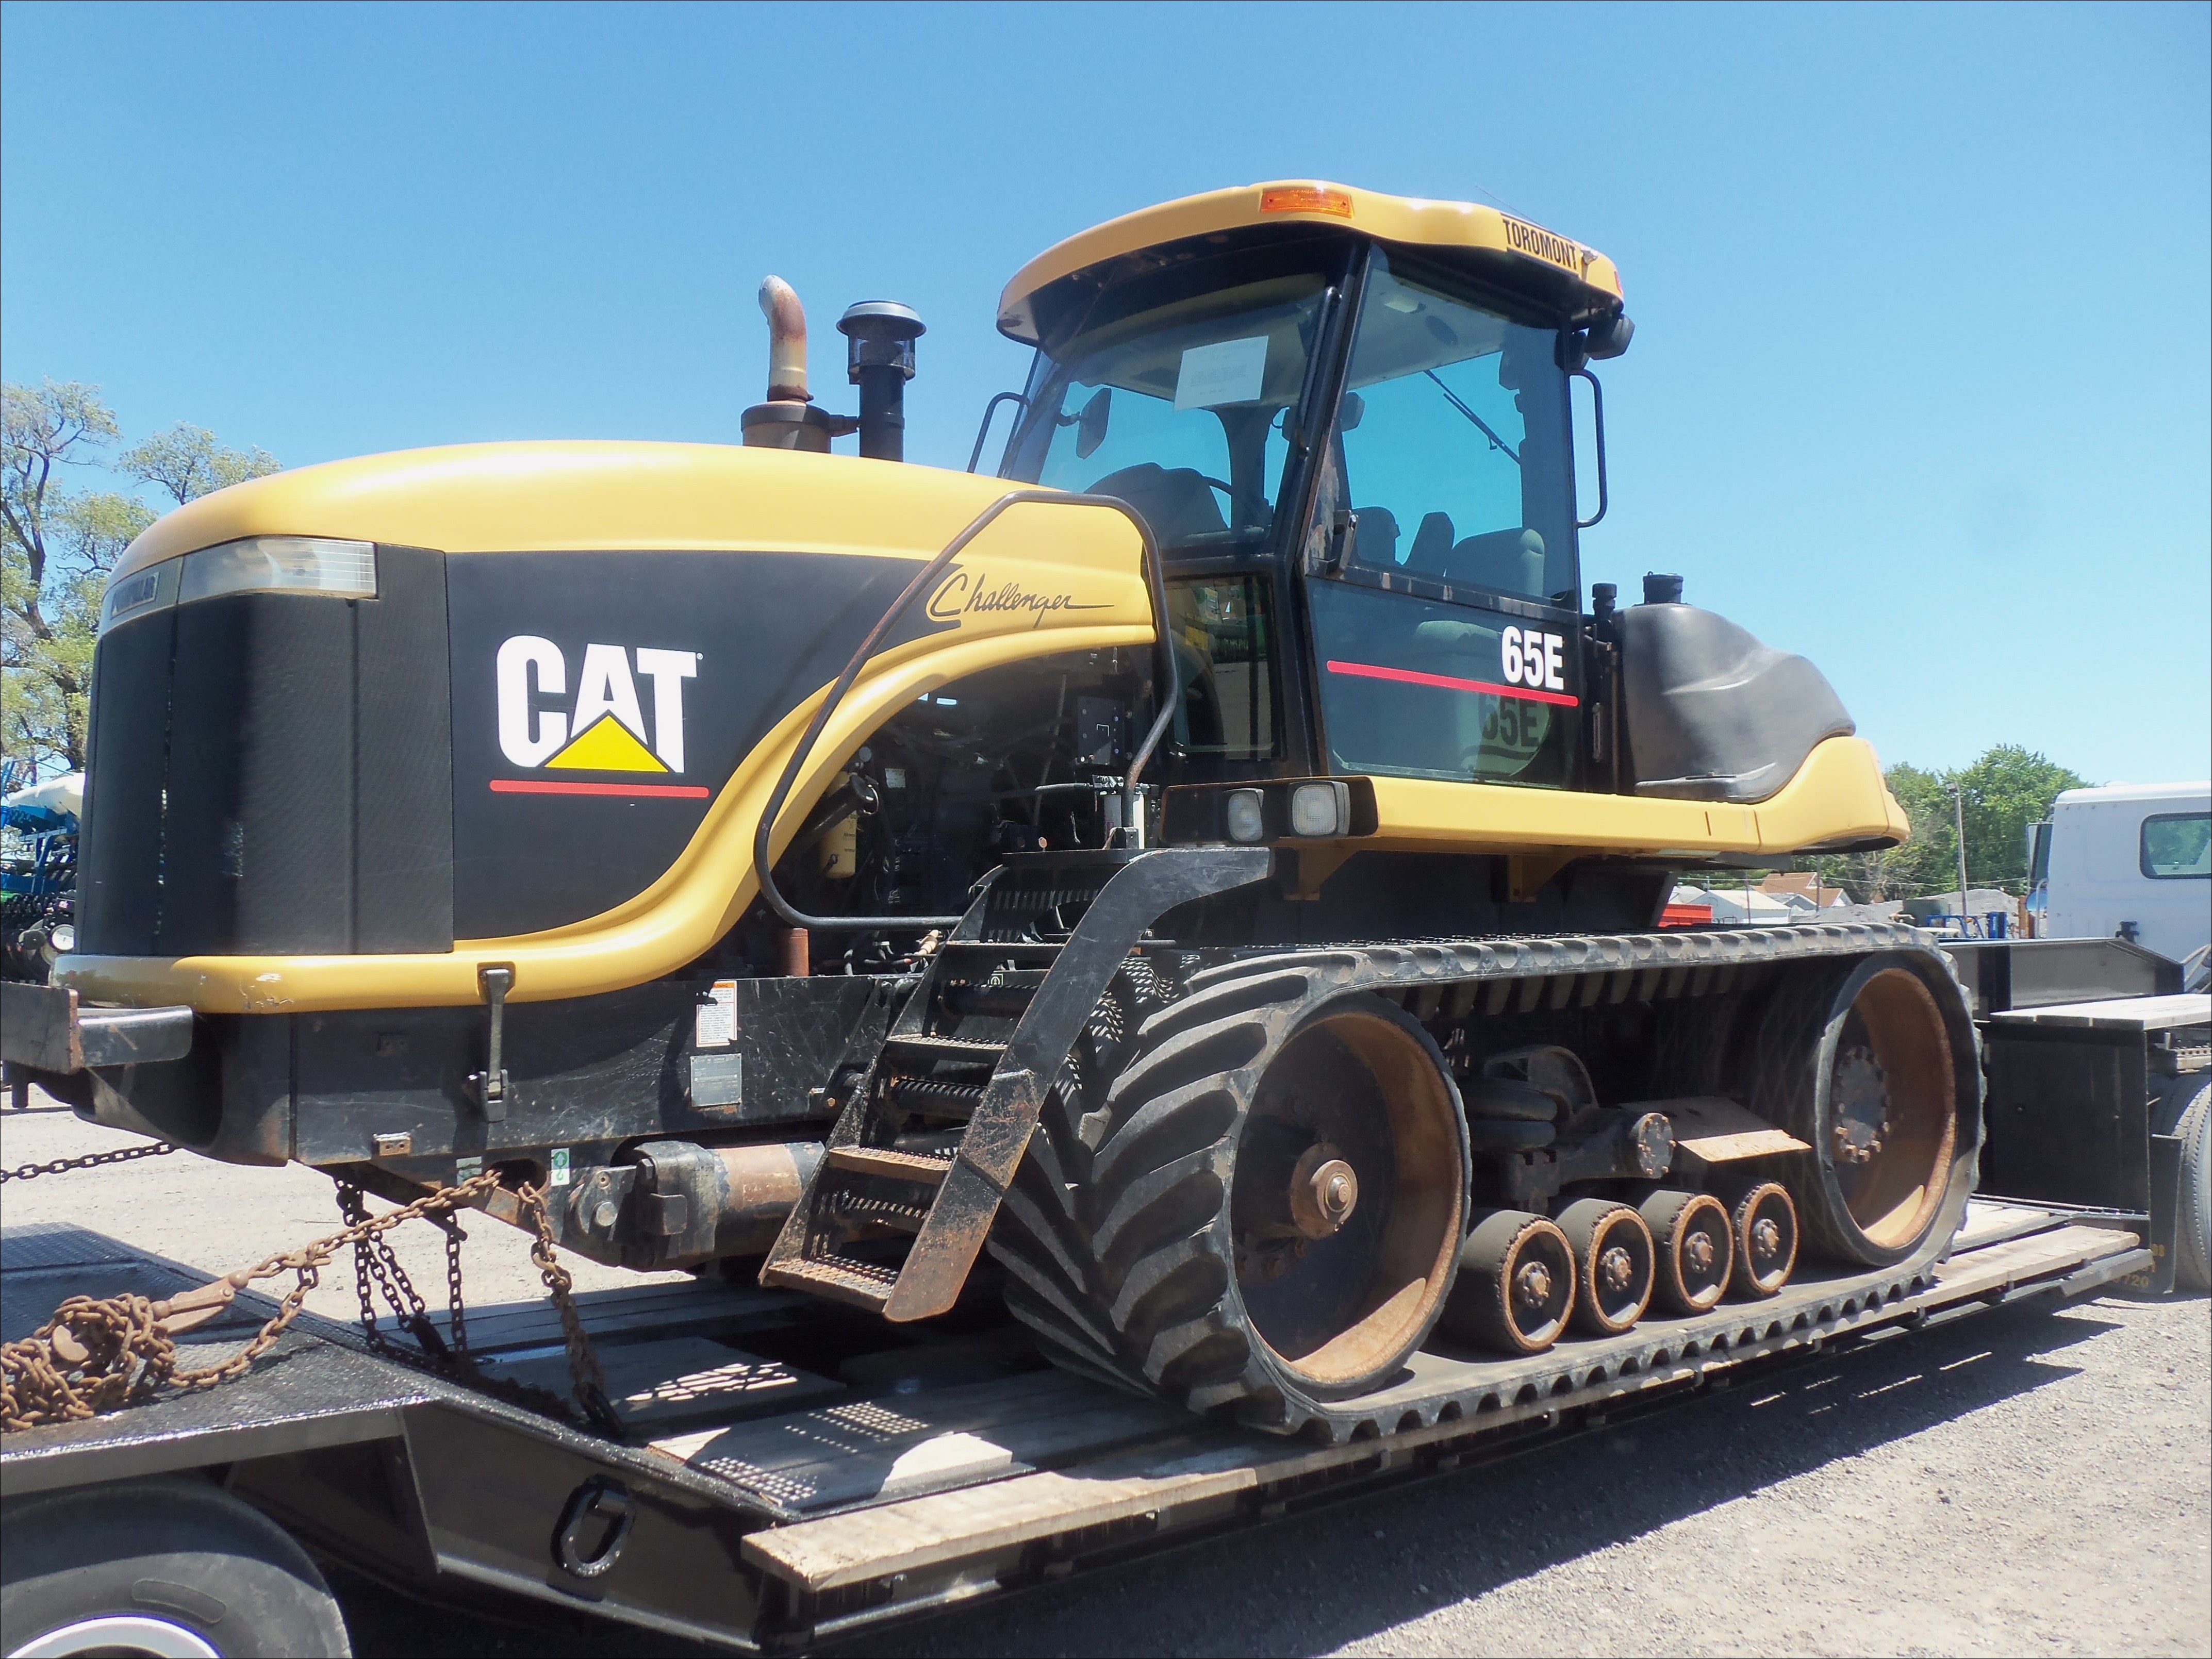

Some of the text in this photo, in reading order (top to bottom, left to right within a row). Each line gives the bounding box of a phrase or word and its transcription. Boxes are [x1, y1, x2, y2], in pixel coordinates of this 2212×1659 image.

[1503, 219, 1577, 270] TOROMONT
[931, 573, 1114, 628] Challenger
[1501, 625, 1564, 690] 65E
[497, 635, 697, 773] CAT
